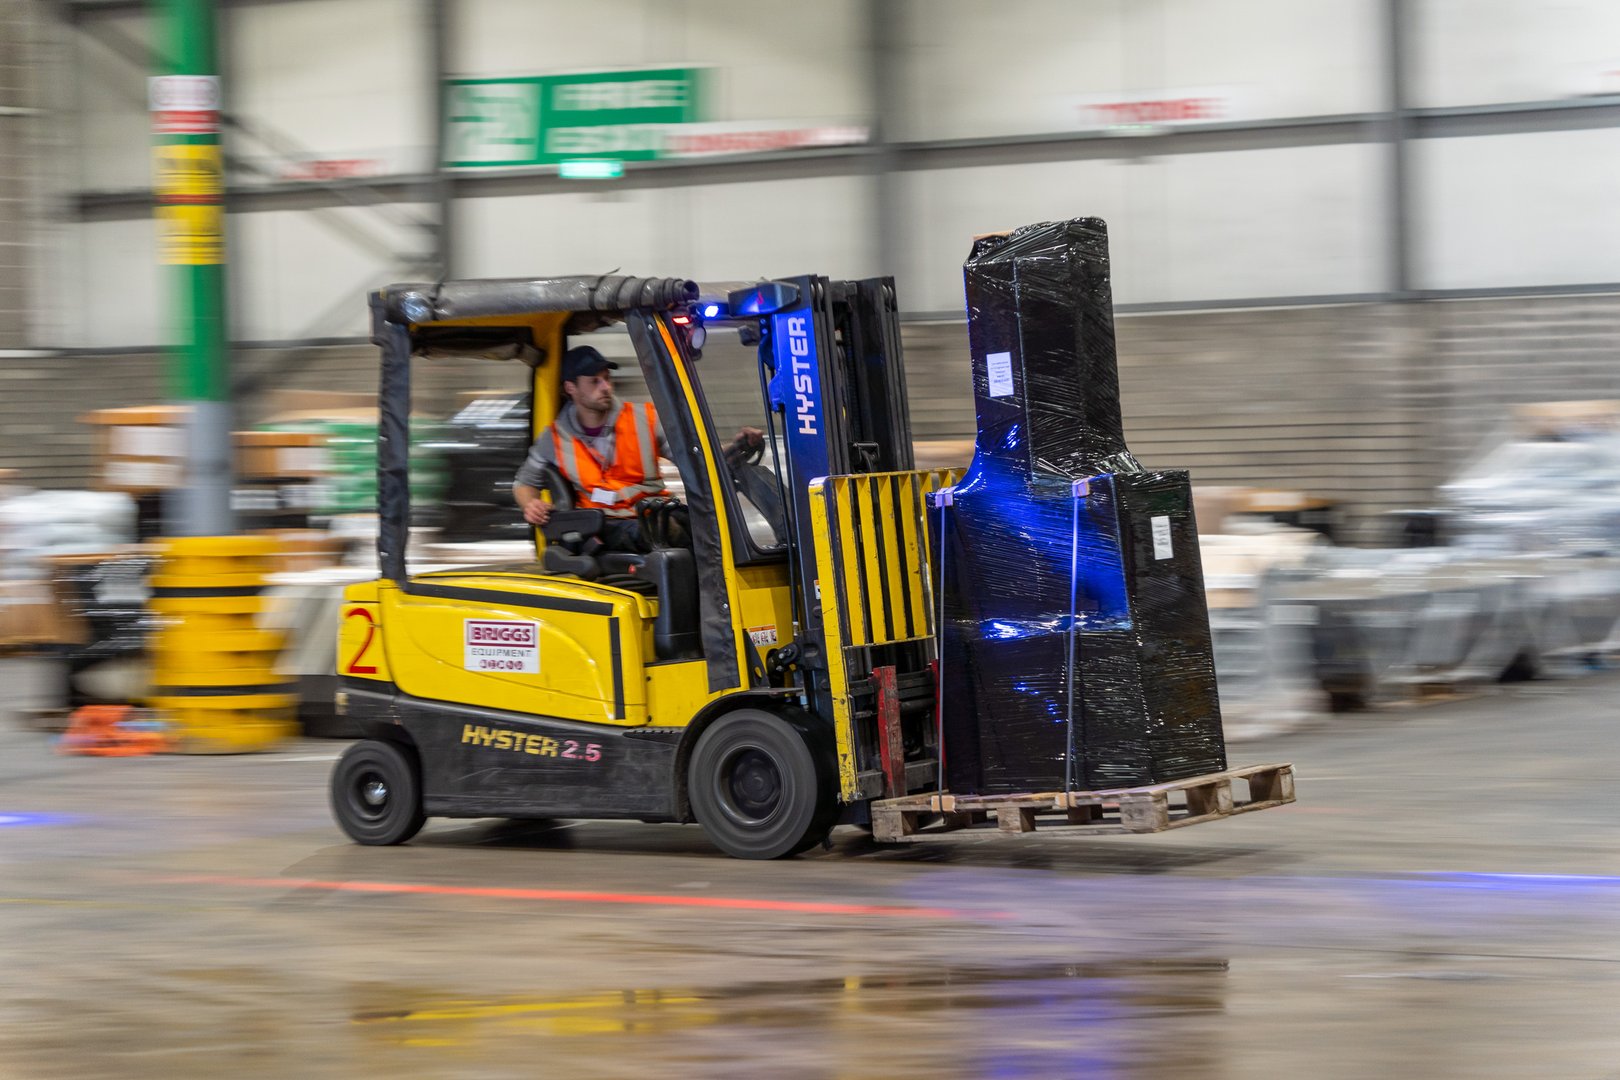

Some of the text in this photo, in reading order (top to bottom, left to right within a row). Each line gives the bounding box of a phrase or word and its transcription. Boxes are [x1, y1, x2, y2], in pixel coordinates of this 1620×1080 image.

[788, 317, 817, 434] HYSTER
[345, 607, 377, 674] 2
[471, 627, 531, 642] BRIGGS
[471, 647, 532, 658] EQUIPMENT
[461, 724, 602, 762] HYSTER 2.5
